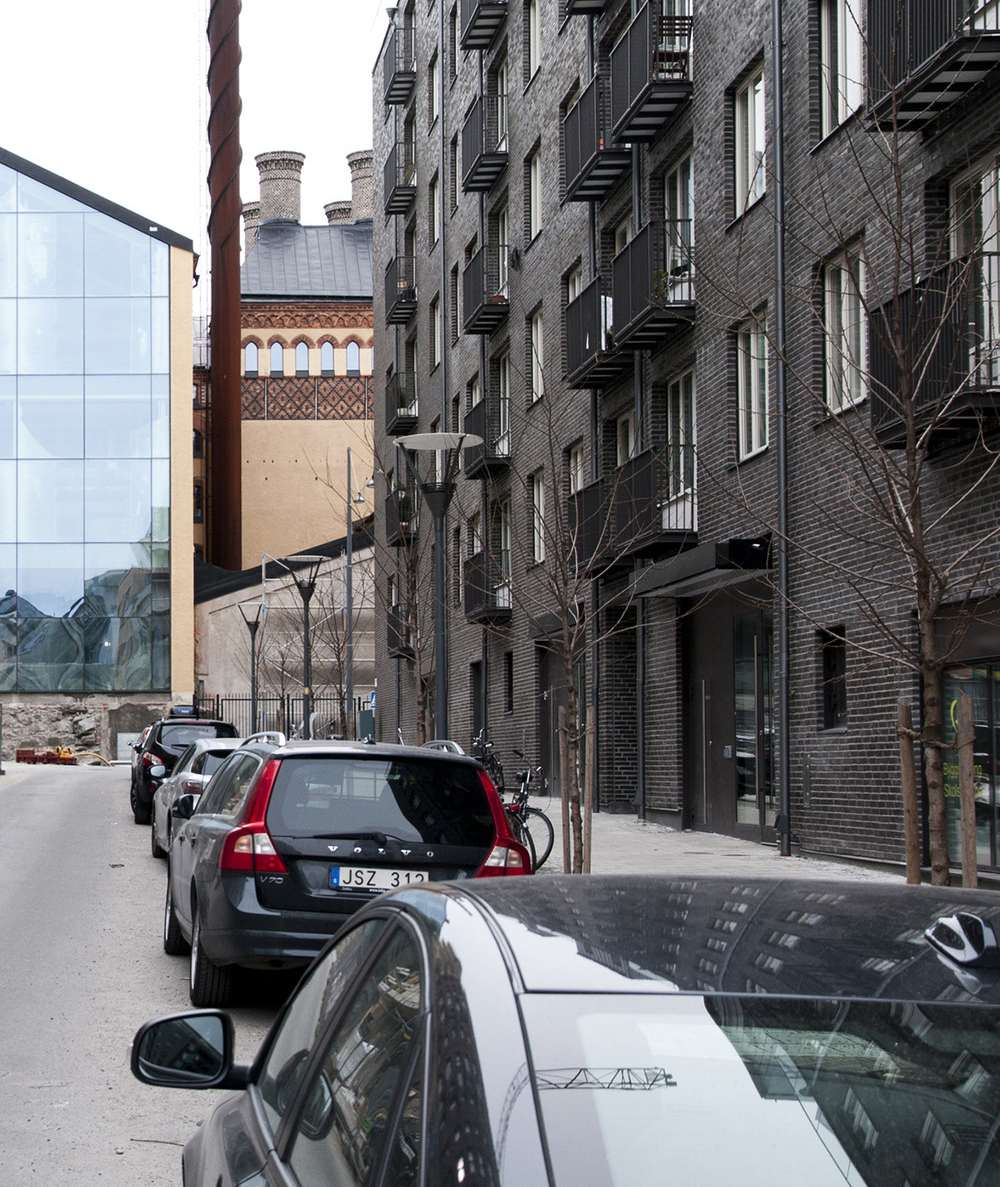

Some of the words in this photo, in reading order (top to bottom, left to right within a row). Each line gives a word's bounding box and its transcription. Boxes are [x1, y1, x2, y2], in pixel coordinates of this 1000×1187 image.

[327, 845, 434, 858] VOLVO
[259, 875, 284, 884] V70
[343, 869, 376, 886] JSZ
